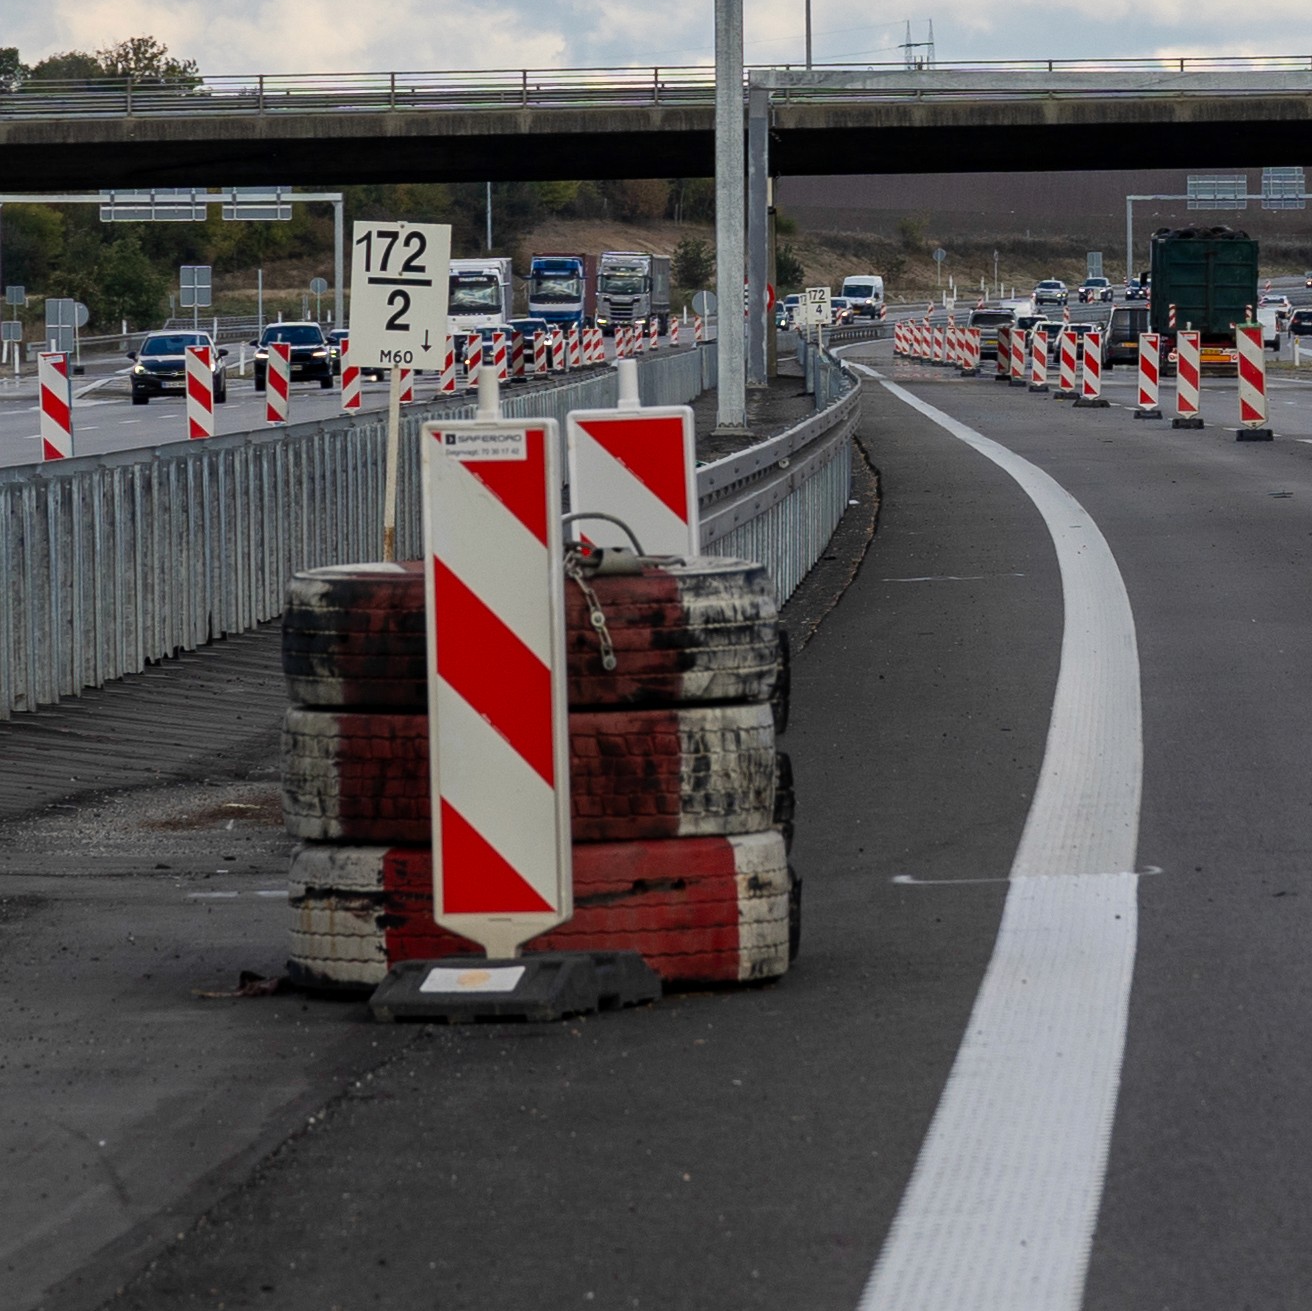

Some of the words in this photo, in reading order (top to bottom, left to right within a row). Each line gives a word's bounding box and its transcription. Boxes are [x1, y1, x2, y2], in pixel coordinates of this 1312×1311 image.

[356, 230, 427, 273] 172
[808, 289, 825, 300] 172
[385, 289, 411, 331] 2
[380, 350, 413, 364] M60
[458, 434, 522, 443] SAFEROAD
